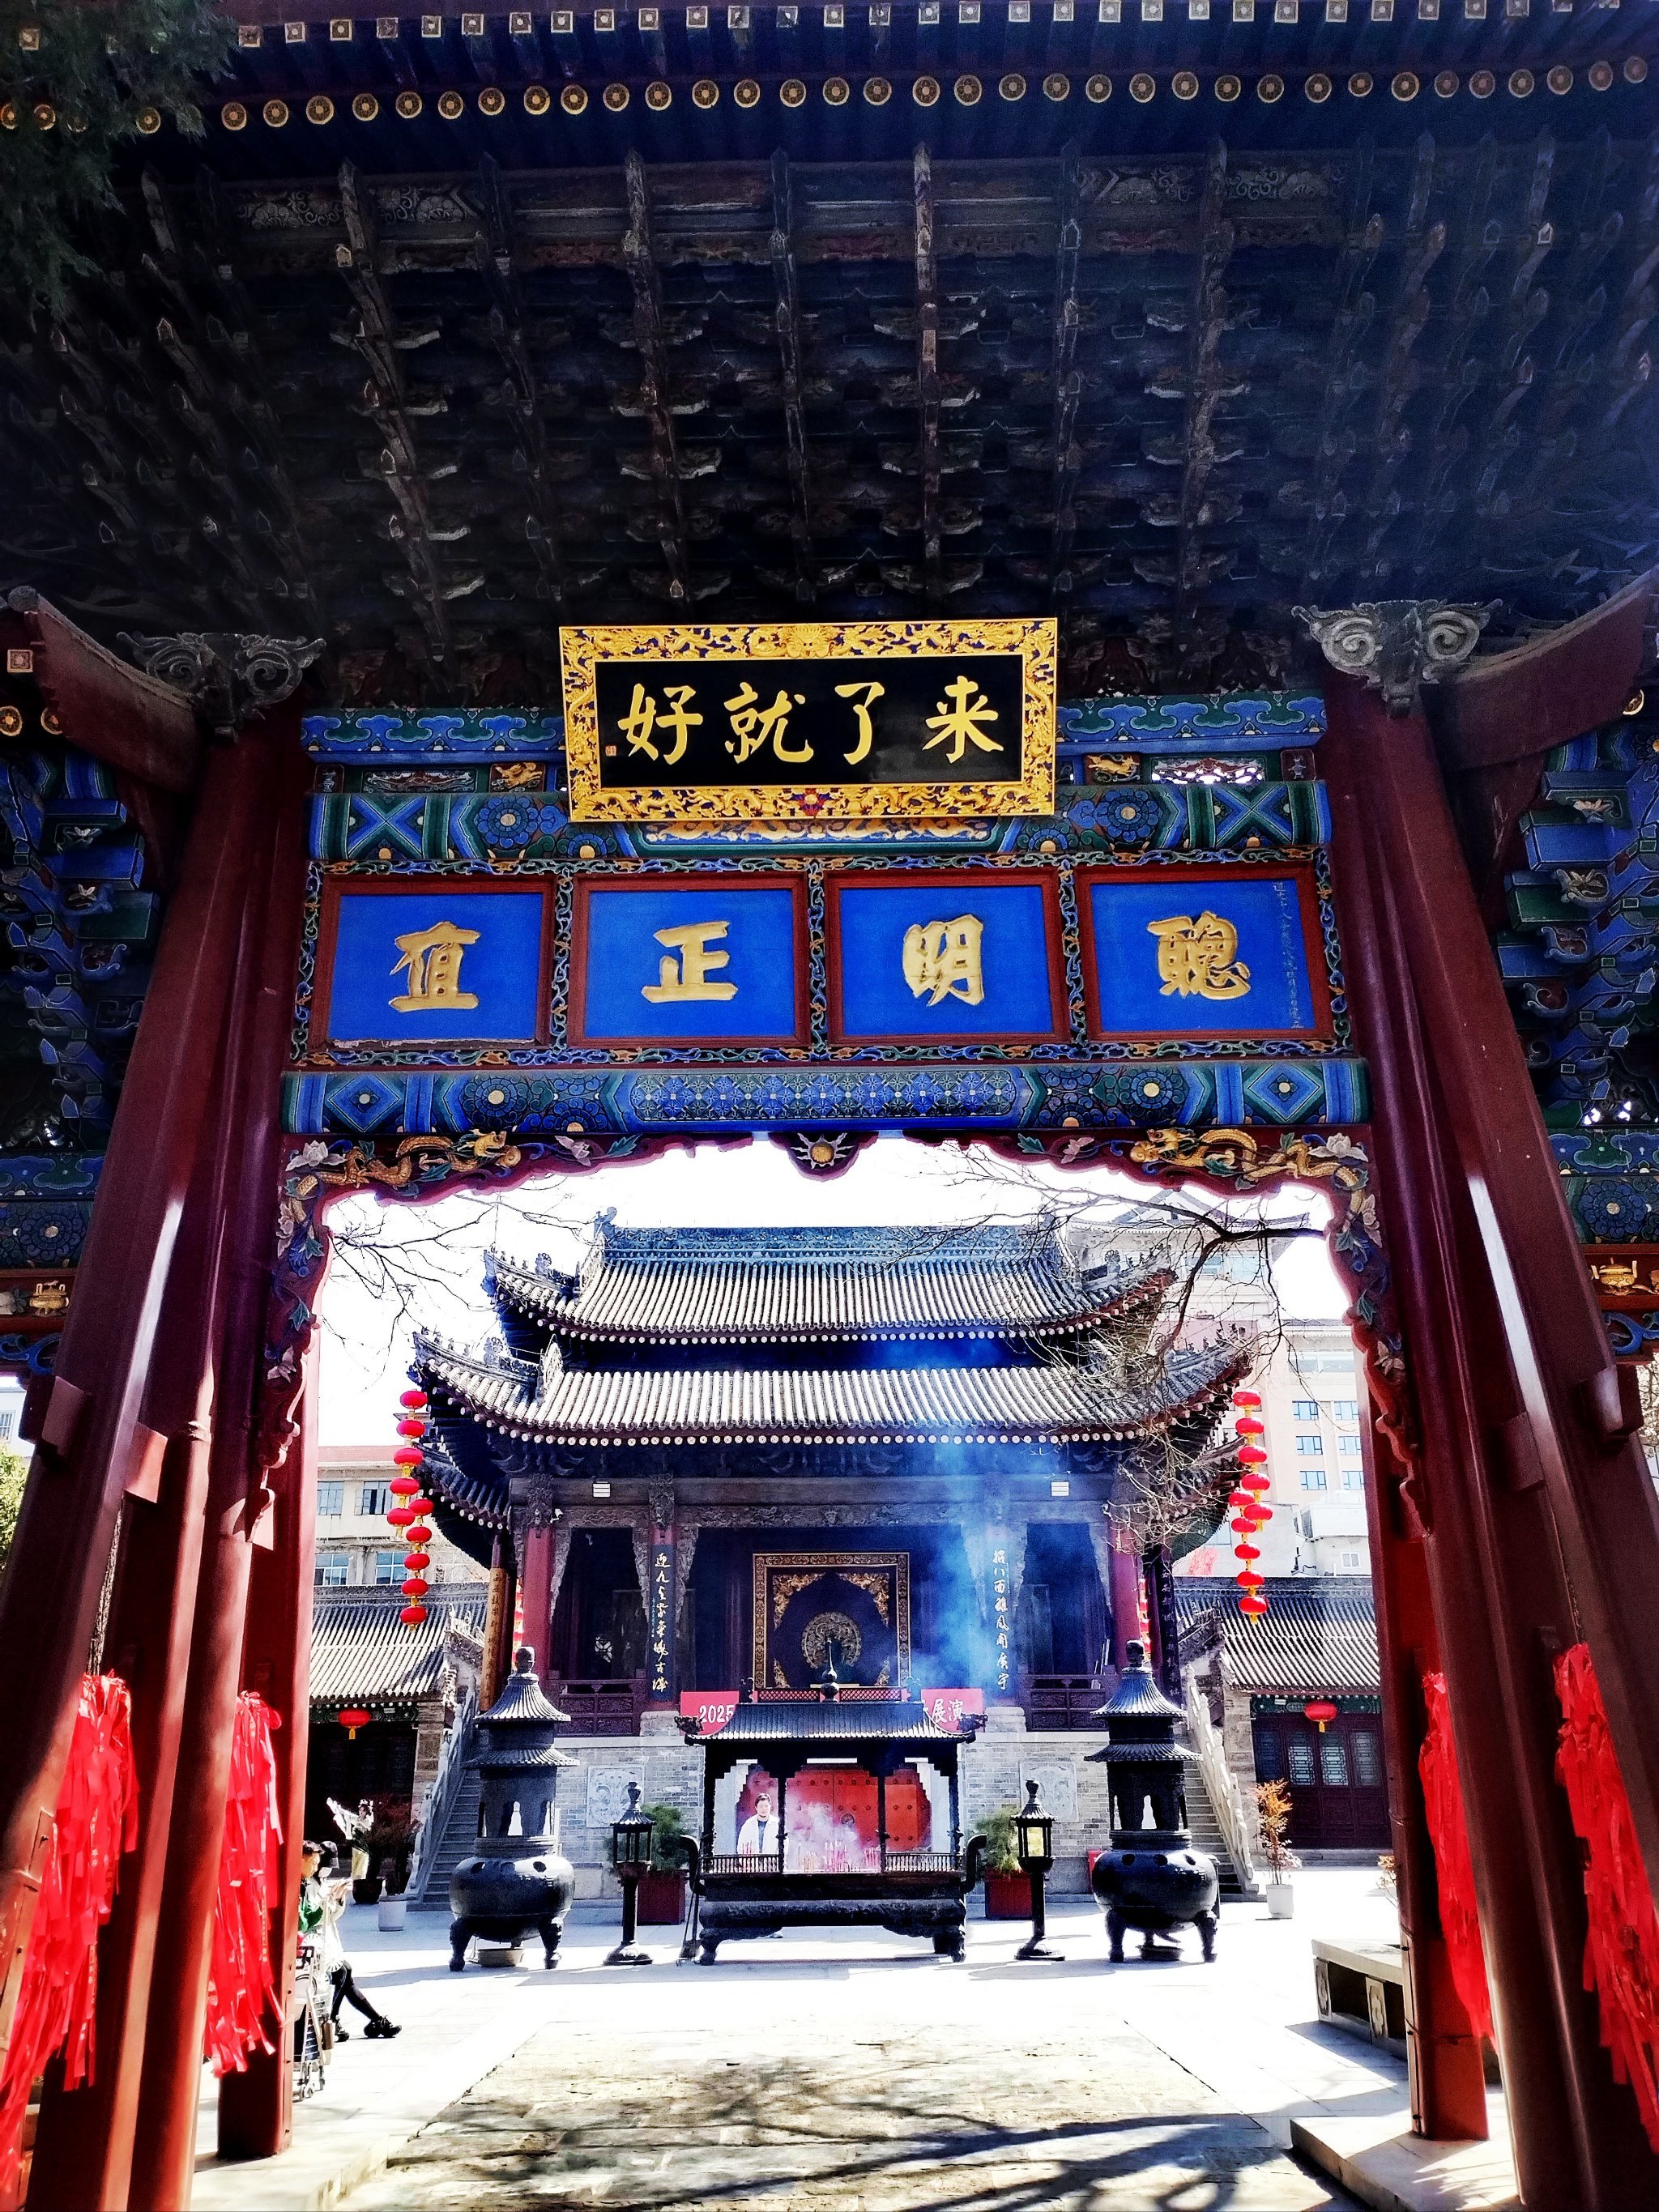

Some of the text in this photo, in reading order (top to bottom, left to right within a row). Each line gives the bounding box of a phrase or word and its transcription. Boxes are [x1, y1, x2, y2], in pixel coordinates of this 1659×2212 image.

[640, 920, 739, 1004] 正
[902, 914, 984, 1007] 明
[699, 1704, 736, 1724] 2025
[932, 1698, 964, 1724] 展演
